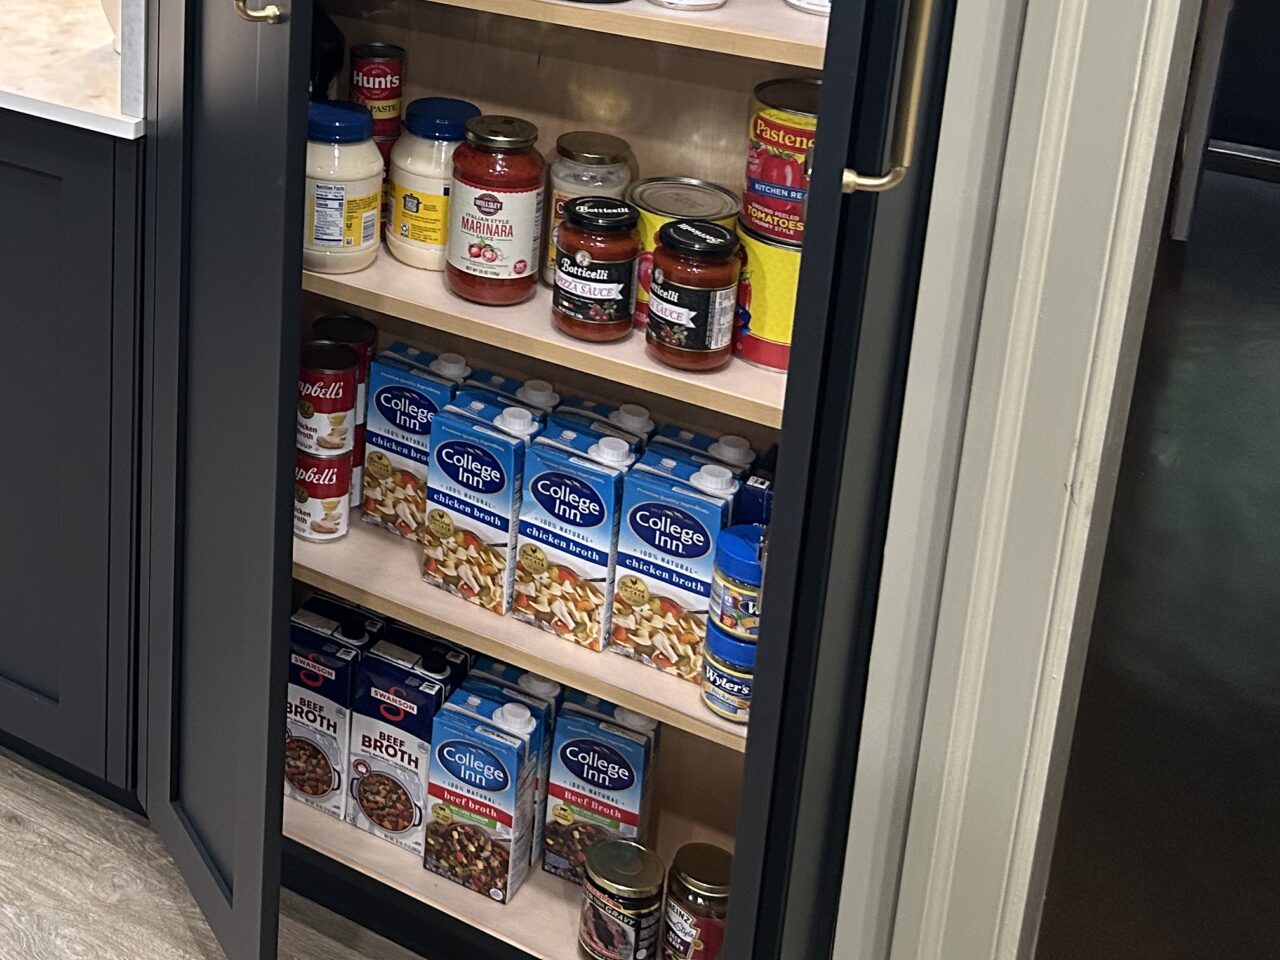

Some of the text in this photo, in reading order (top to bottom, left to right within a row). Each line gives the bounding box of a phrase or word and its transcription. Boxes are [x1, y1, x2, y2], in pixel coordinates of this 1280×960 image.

[370, 103, 397, 113] PASTE
[754, 182, 789, 197] KITCHEN
[465, 212, 489, 222] ITALIAN
[575, 205, 629, 214] Botticelli
[747, 204, 805, 231] TOMATOES
[751, 201, 800, 221] GROUND PEELED
[461, 215, 514, 238] MARINARA
[476, 234, 494, 242] SAUCE
[774, 223, 795, 235] STYLE
[561, 257, 609, 280] Botticelli
[556, 276, 614, 298] PIZZA SAUCE
[656, 305, 685, 322] SAUCE
[396, 410, 420, 431] Inn
[384, 427, 399, 438] 100%
[372, 434, 409, 456] chicken
[441, 448, 501, 483] College
[458, 467, 483, 489] Inn
[445, 485, 493, 509] 100% NATURAL
[537, 480, 600, 516] College
[433, 492, 501, 526] chicken broth
[554, 499, 581, 523] Inn
[540, 518, 589, 543] 100% NATURAL
[635, 510, 705, 546] College
[526, 526, 600, 561] chicken broth
[654, 530, 683, 554] Inn
[639, 549, 694, 574] 100% NATURAL
[625, 558, 705, 593] chicken broth
[293, 655, 333, 678] SWANSON
[705, 664, 750, 695] Wyler's
[299, 697, 325, 714] BEEF
[373, 689, 416, 712] SWANSON
[286, 702, 338, 735] BROTH
[379, 730, 406, 748] BEEF
[361, 734, 419, 770] BROTH
[566, 746, 629, 780] College
[443, 746, 504, 782] College
[583, 764, 610, 786] Inn
[460, 765, 486, 787] Inn
[447, 781, 495, 805] 100% NATURAL
[569, 780, 619, 804] 100% NATURAL
[444, 790, 467, 806] beef
[468, 799, 498, 818] broth
[564, 790, 622, 819] Beef Broth
[605, 905, 636, 926] GRAVY
